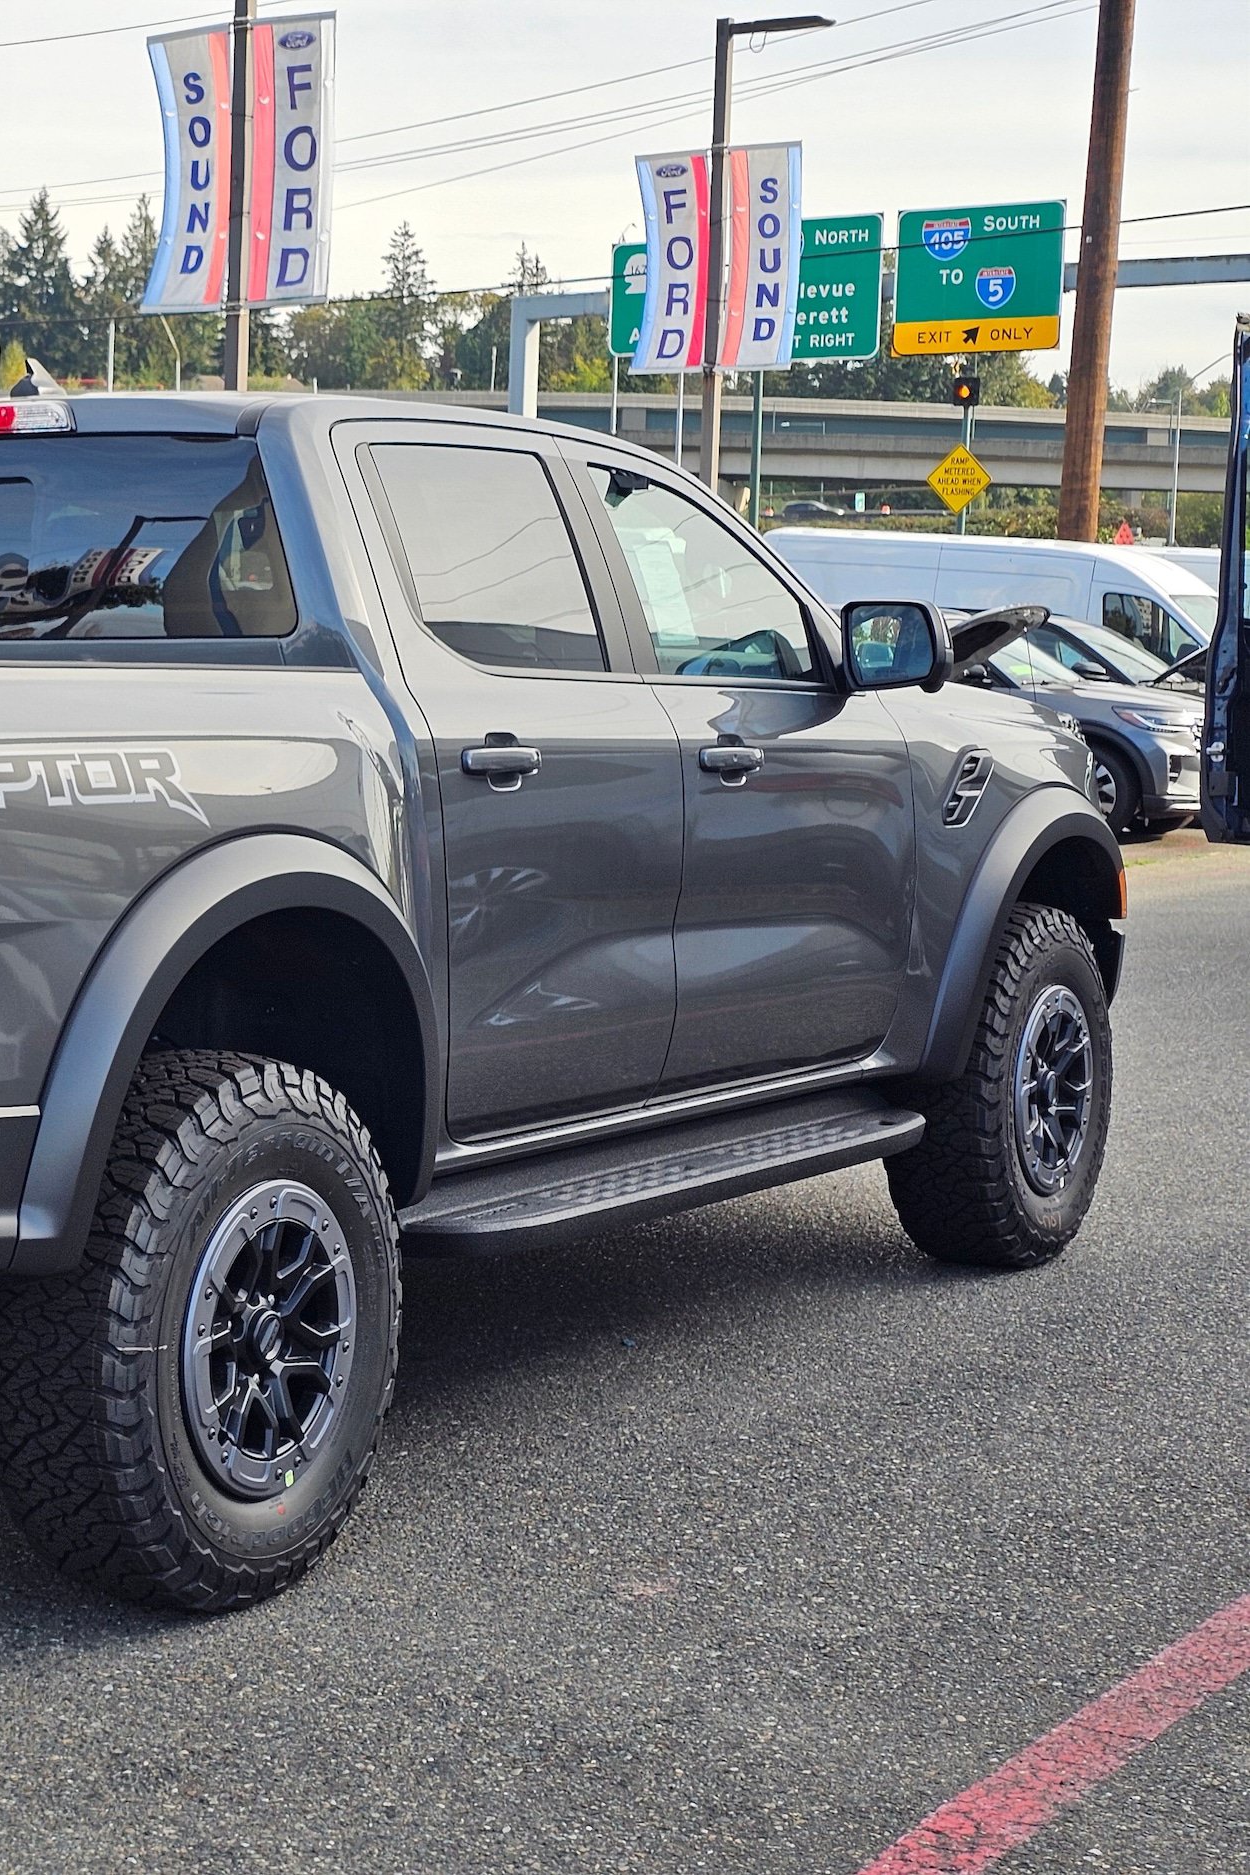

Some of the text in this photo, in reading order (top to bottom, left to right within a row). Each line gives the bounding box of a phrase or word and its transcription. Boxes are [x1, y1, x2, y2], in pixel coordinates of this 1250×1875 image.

[282, 32, 313, 49] Ford
[180, 72, 212, 274] SOUND
[276, 64, 316, 288] FORD
[659, 165, 685, 178] Ford
[983, 215, 1040, 232] SOUTH
[815, 229, 869, 245] NORTH
[930, 231, 965, 250] 405
[753, 178, 781, 341] SOUND
[656, 189, 693, 359] FORD
[939, 268, 963, 285] TO
[988, 279, 1004, 302] 5
[810, 333, 856, 348] RIGHT
[918, 327, 1033, 344] EXIT ONLY
[951, 457, 970, 465] RAMP
[944, 467, 976, 476] METERED
[937, 477, 982, 486] AHEAD WHEN
[942, 487, 975, 496] FLASHING
